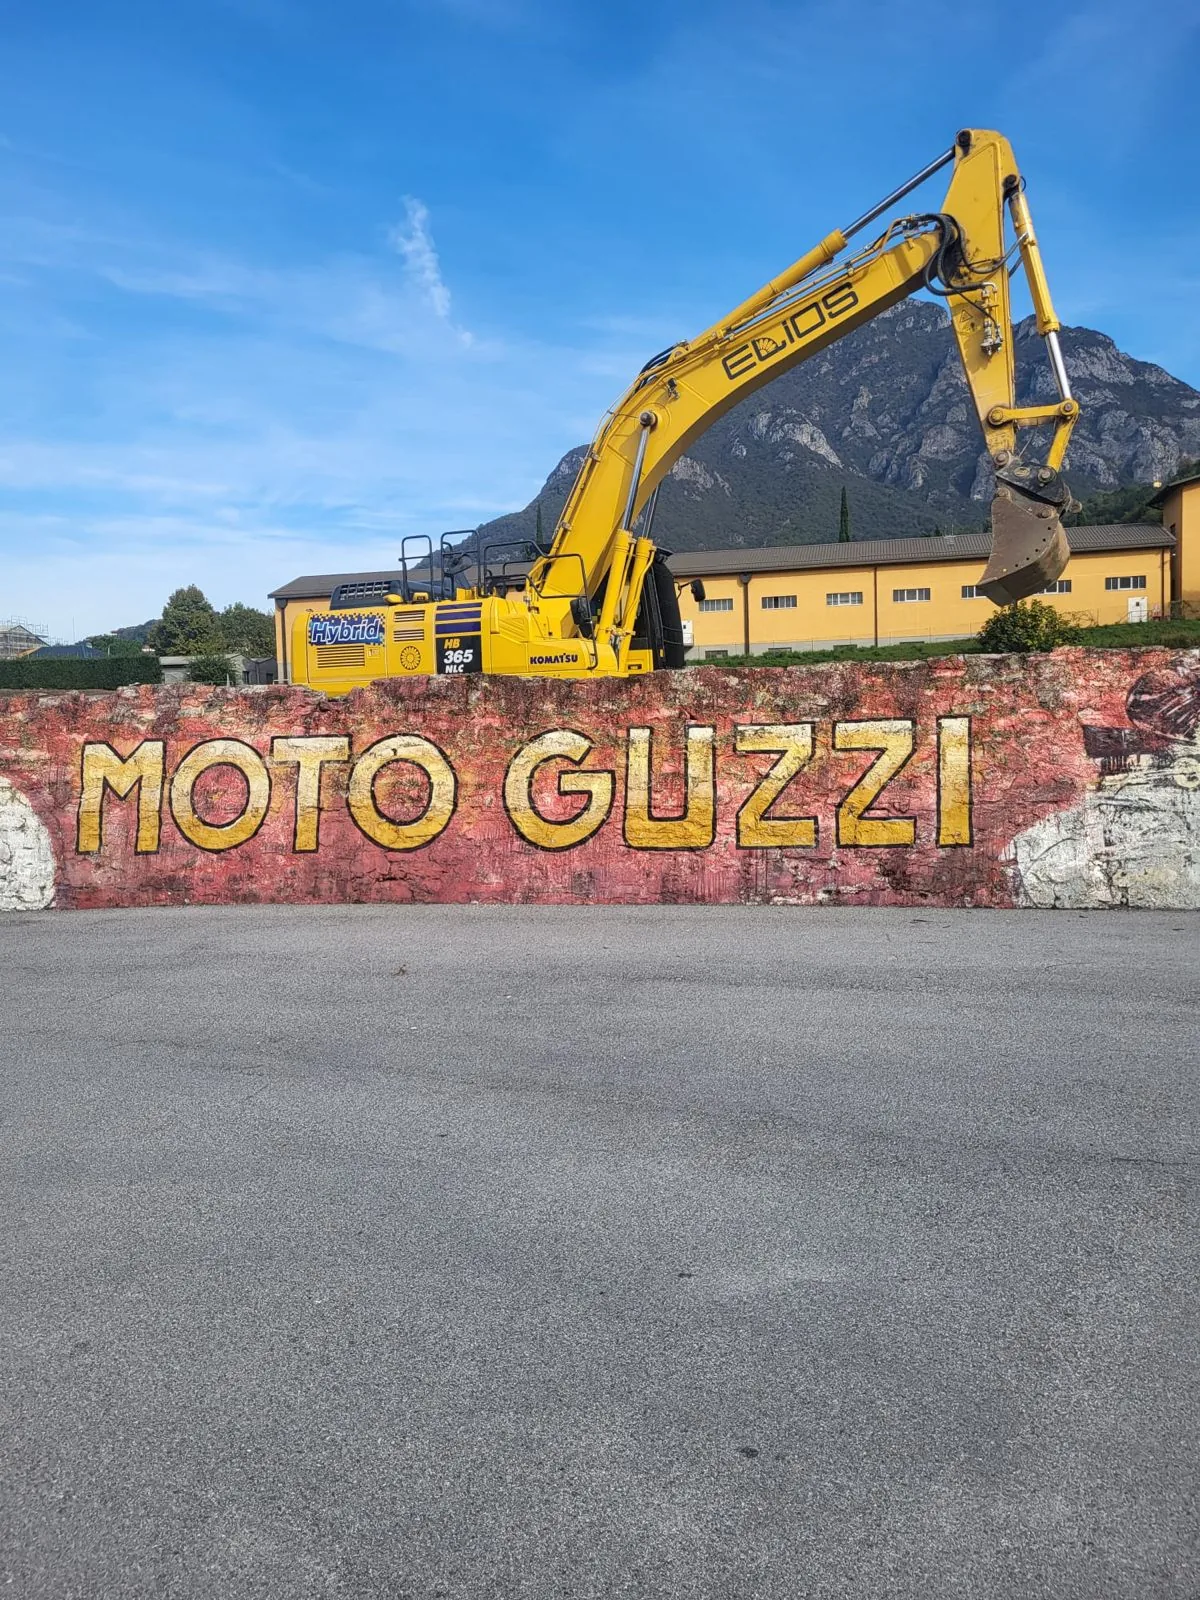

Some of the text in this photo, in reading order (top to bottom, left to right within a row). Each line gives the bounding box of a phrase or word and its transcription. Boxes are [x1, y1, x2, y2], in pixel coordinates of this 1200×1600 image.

[311, 618, 381, 645] Hybrid
[443, 638, 461, 649] HB
[443, 649, 474, 664] 365
[529, 652, 579, 665] KOMATSU
[445, 664, 464, 674] NLC
[75, 715, 975, 855] MOTO GUZZI
